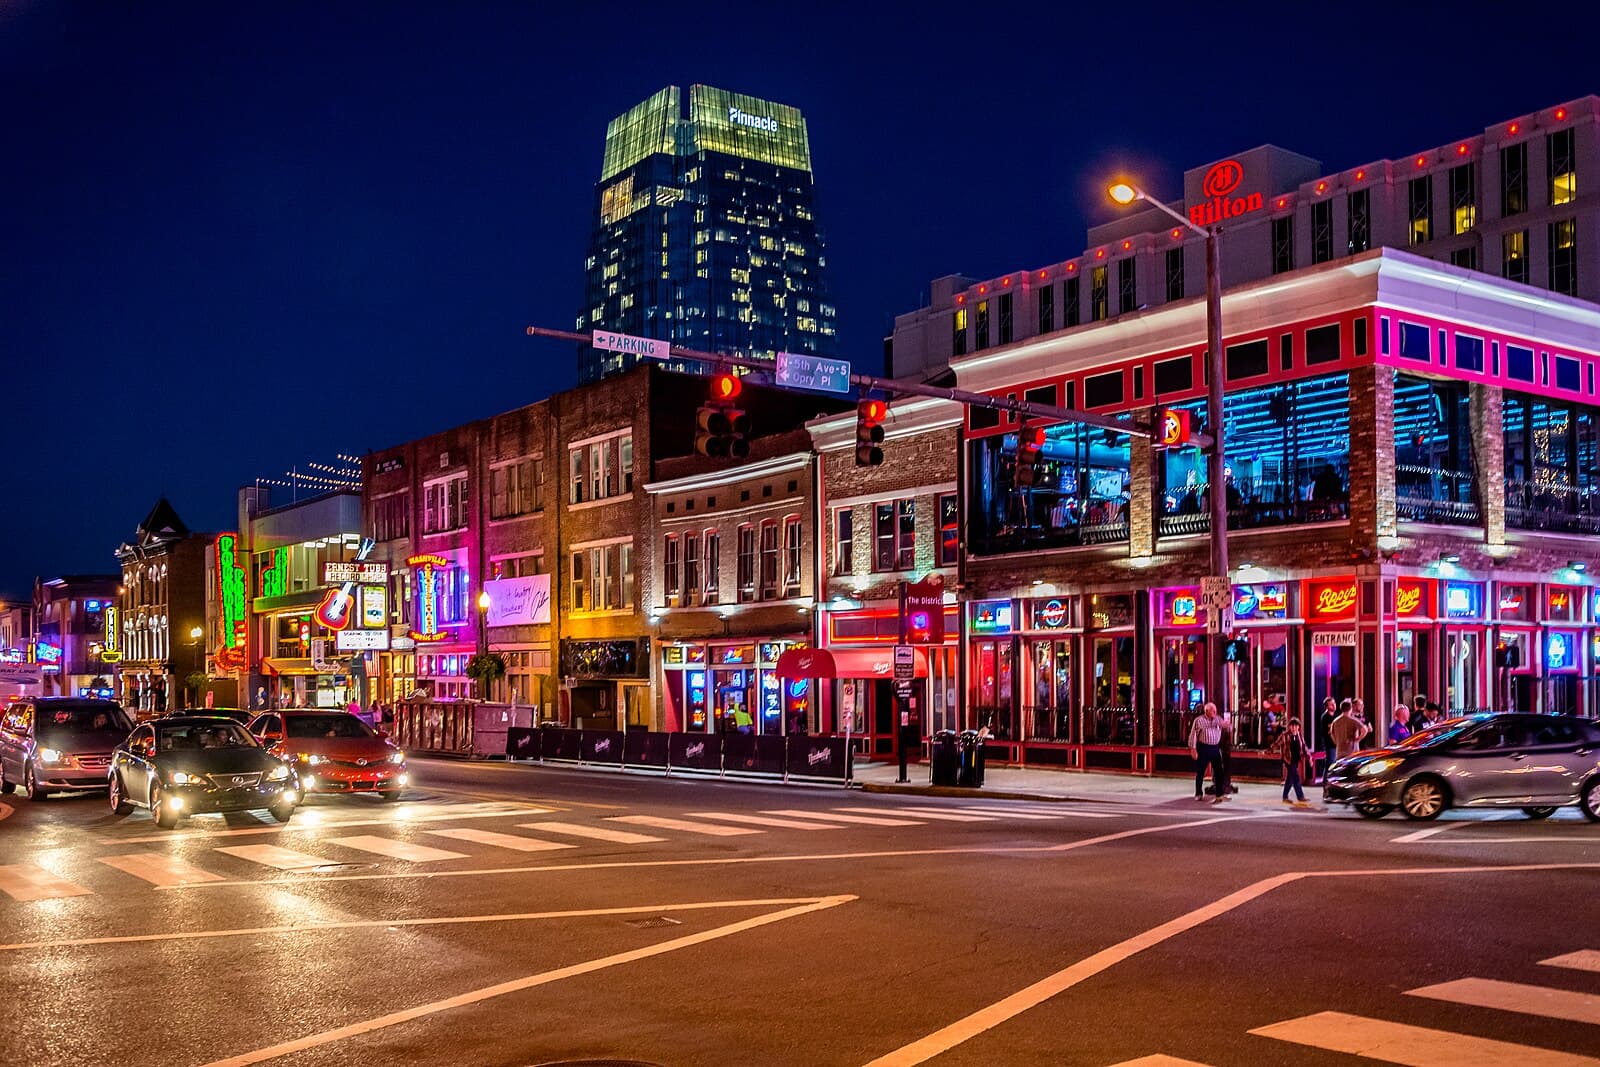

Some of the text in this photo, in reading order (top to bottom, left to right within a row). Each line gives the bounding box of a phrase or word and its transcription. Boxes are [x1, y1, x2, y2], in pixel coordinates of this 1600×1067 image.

[728, 105, 777, 132] Pinnacle
[1189, 192, 1263, 226] Hilton
[608, 335, 655, 354] PARKING
[792, 371, 831, 386] Opry Pl
[409, 555, 447, 566] NASHVILLE
[326, 563, 386, 573] ERNEST TUBB
[330, 573, 360, 581] RECORD
[908, 596, 919, 605] The
[1202, 593, 1214, 605] OK
